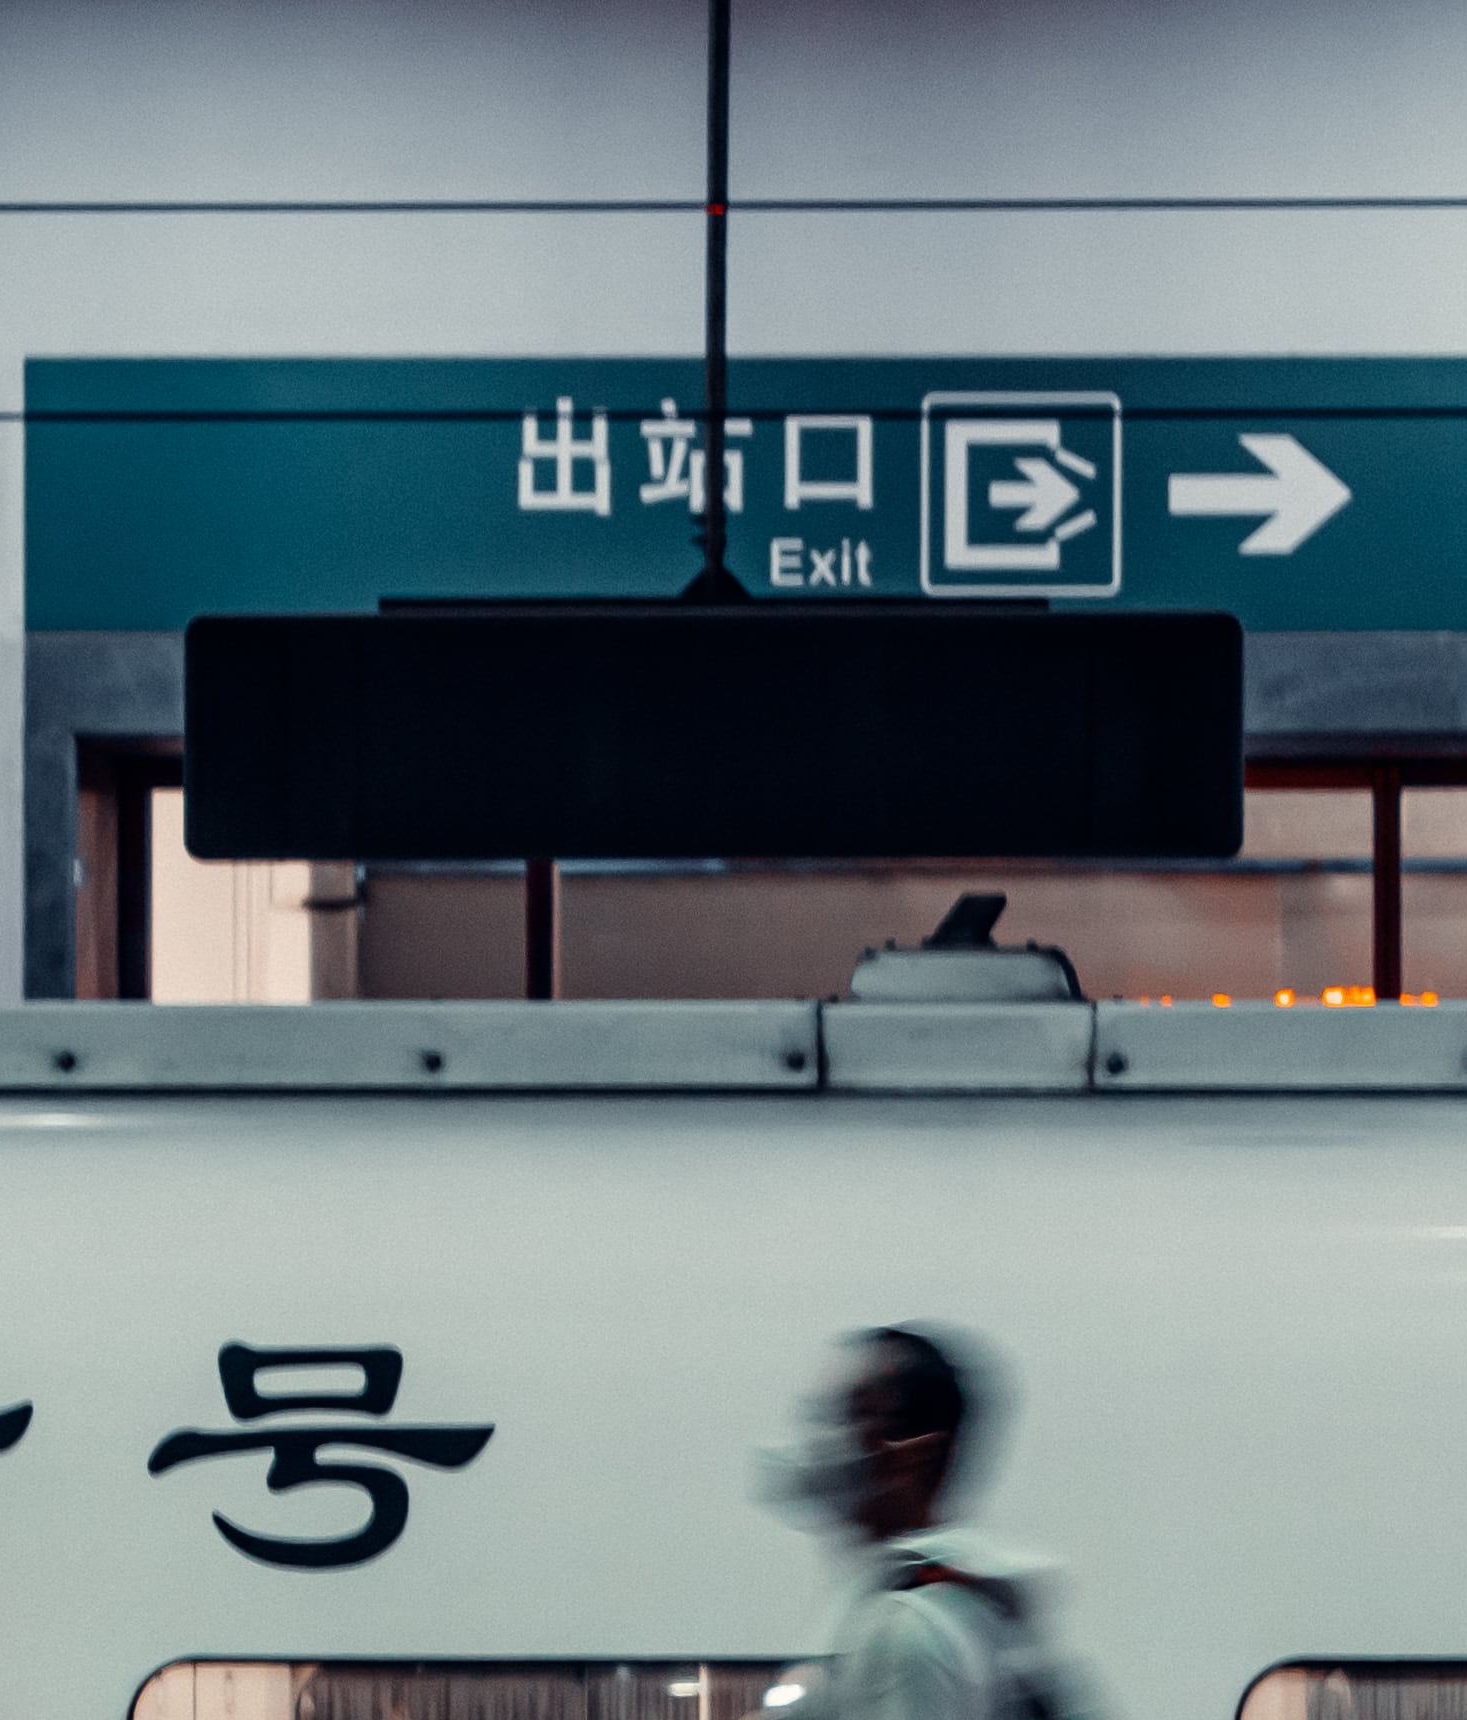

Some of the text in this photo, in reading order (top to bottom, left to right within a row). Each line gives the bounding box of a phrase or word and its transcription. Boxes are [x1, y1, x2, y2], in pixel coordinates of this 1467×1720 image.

[518, 396, 873, 517] 出站口
[770, 538, 872, 587] Exit
